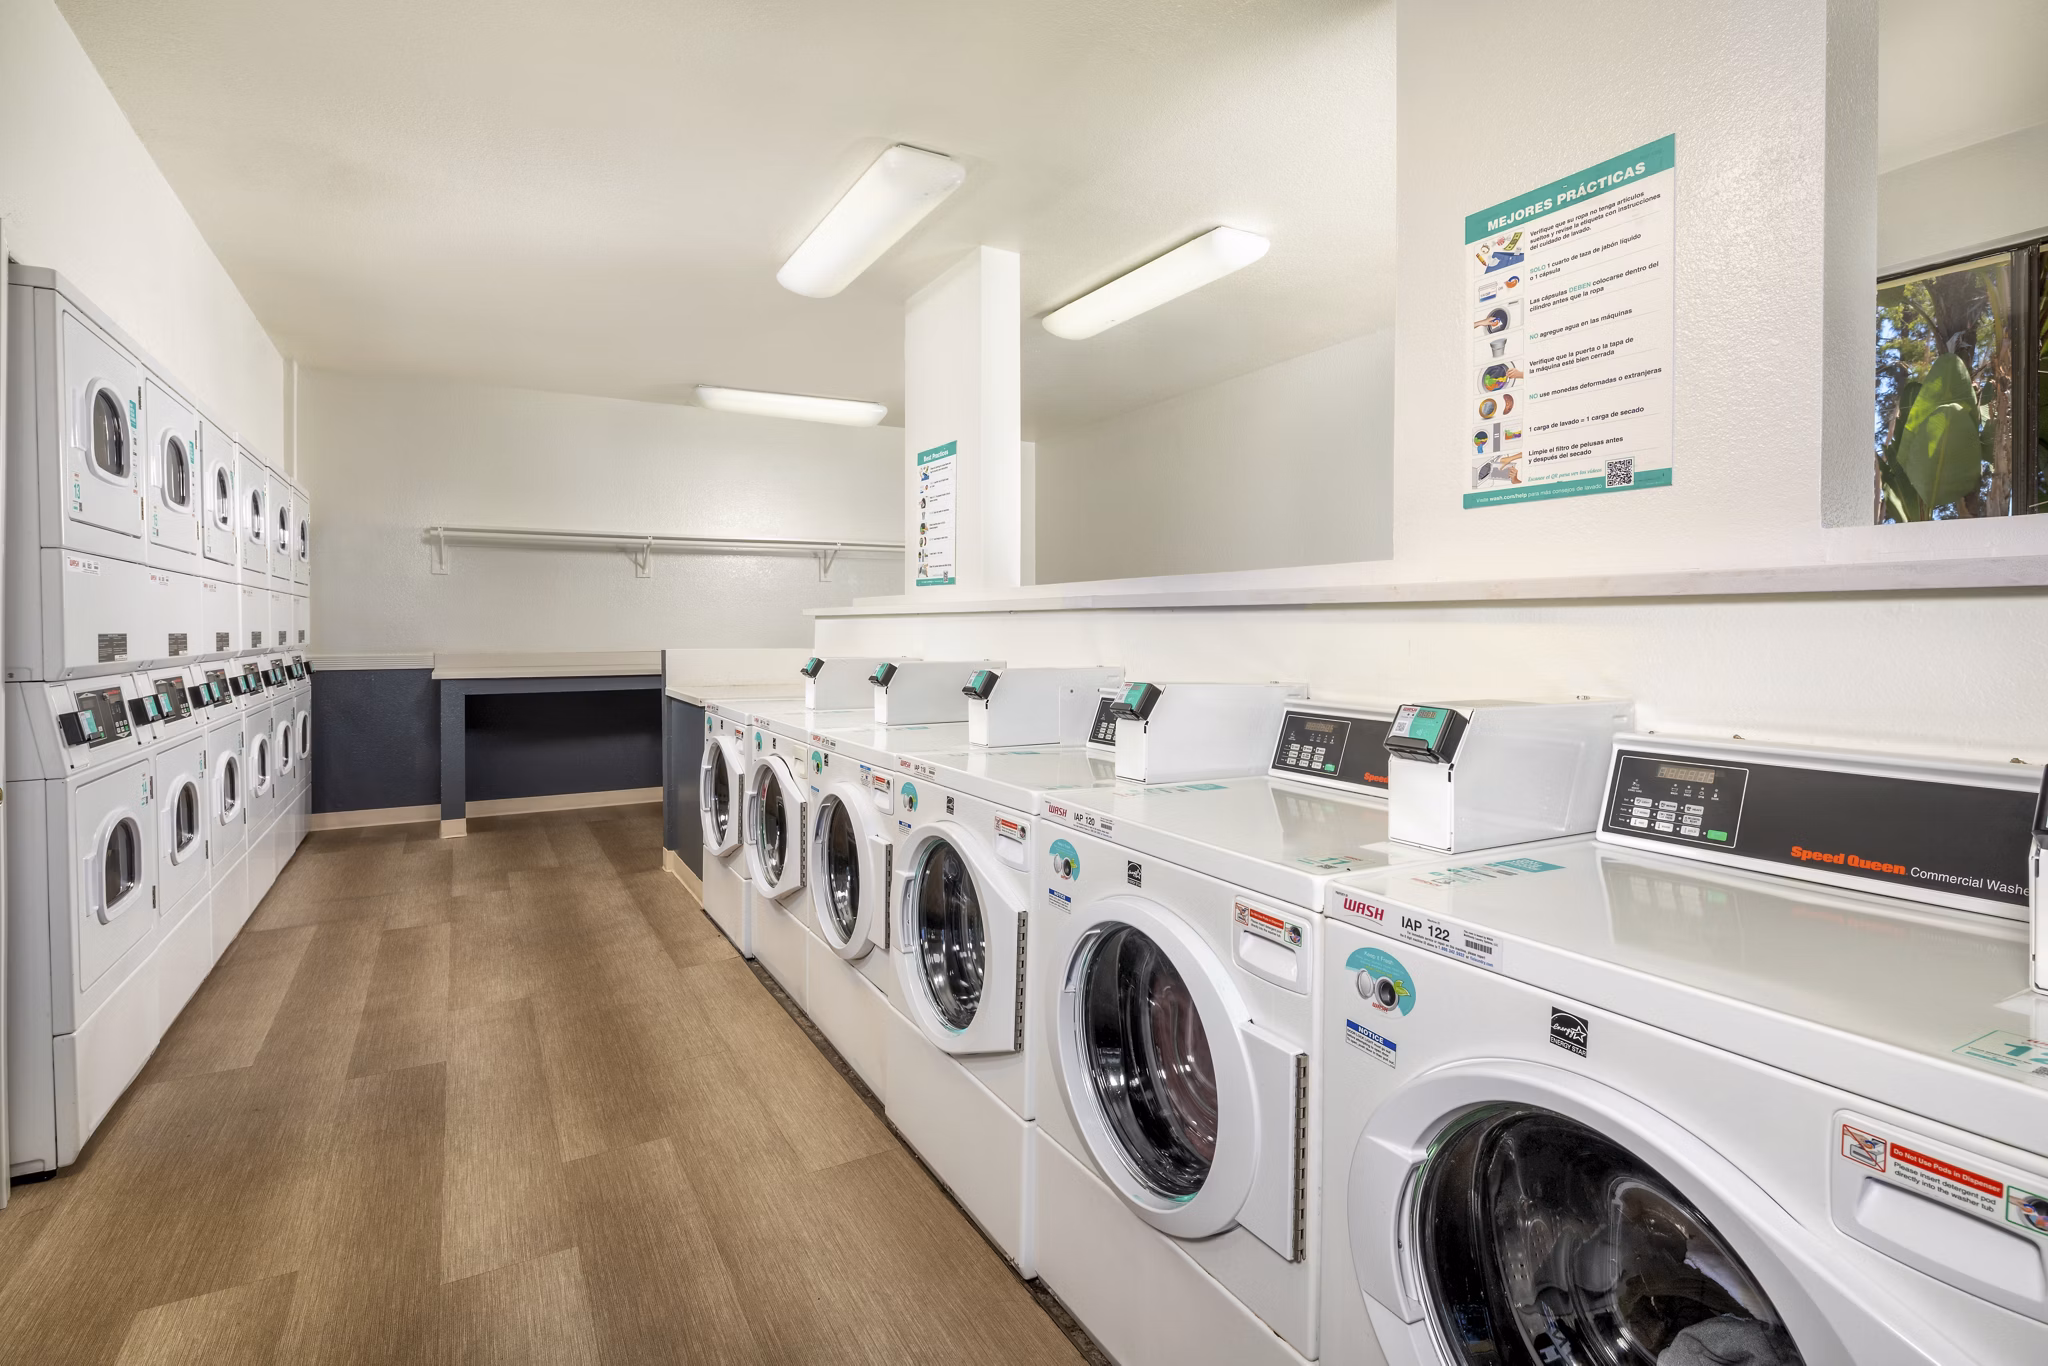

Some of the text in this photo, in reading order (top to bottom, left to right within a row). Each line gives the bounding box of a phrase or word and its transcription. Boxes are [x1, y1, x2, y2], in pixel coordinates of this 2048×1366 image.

[1487, 162, 1645, 231] MEJORES PRÁCTICAS
[1530, 232, 1550, 244] sueltos
[1556, 225, 1573, 234] revise
[1581, 214, 1604, 226] etiqueta
[1605, 210, 1617, 218] con
[1618, 193, 1661, 213] instrucciones
[1530, 224, 1554, 236] Verifique
[1555, 220, 1566, 230] que
[1575, 212, 1588, 222] ropa
[1590, 208, 1598, 216] no
[1599, 202, 1616, 212] tenga
[1530, 243, 1539, 251] del
[1540, 236, 1562, 248] cuidado
[1571, 226, 1592, 237] lavado.
[1529, 264, 1546, 274] SOLO
[1552, 257, 1570, 267] cuarto
[1579, 250, 1592, 258] taza
[1601, 240, 1618, 252] jabón
[1539, 267, 1560, 278] cápsula
[1541, 289, 1568, 302] cápsulas
[1568, 282, 1592, 293] DEBEN
[1592, 272, 1624, 286] colocarse
[1624, 265, 1646, 276] dentro
[1648, 260, 1659, 269] del
[1529, 301, 1551, 312] cilindro
[1552, 297, 1568, 306] antes
[1569, 293, 1582, 302] que
[1590, 286, 1604, 295] ropa
[1539, 327, 1564, 338] agregue
[1564, 322, 1580, 331] agua
[1600, 308, 1632, 321] máquinas
[1529, 356, 1554, 367] Verifique
[1556, 354, 1568, 362] que
[1575, 346, 1596, 356] puerta
[1609, 340, 1624, 348] tapa
[1535, 363, 1560, 373] máquina
[1576, 355, 1589, 363] bien
[1590, 349, 1614, 360] cerrada
[1551, 385, 1578, 396] monedas
[1580, 377, 1616, 390] deformadas
[1624, 367, 1662, 380] extranjeras
[1533, 424, 1550, 432] carga
[1559, 418, 1580, 427] lavado
[1591, 413, 1609, 422] carga
[1620, 406, 1644, 416] secado
[1528, 448, 1548, 457] Limpie
[1555, 444, 1570, 452] filtro
[1580, 440, 1604, 450] pelusas
[1605, 436, 1624, 444] antes
[1533, 455, 1558, 464] después
[1570, 449, 1592, 458] secado
[1489, 492, 1528, 502] wash.com/help
[1552, 487, 1576, 495] consejos
[1048, 804, 1068, 818] WASH
[1790, 845, 2030, 897] Speed Queen Commercial Washe
[1343, 897, 1450, 943] WASH IAP 122
[1358, 1025, 1384, 1044] NOTICE
[1550, 1036, 1572, 1050] ENERGY
[1893, 1147, 2001, 1193] Do Not Use Pods in Dispenser
[1893, 1161, 1996, 1206] Please insert detergent pod
[1894, 1169, 1995, 1213] directly into the washer tub
